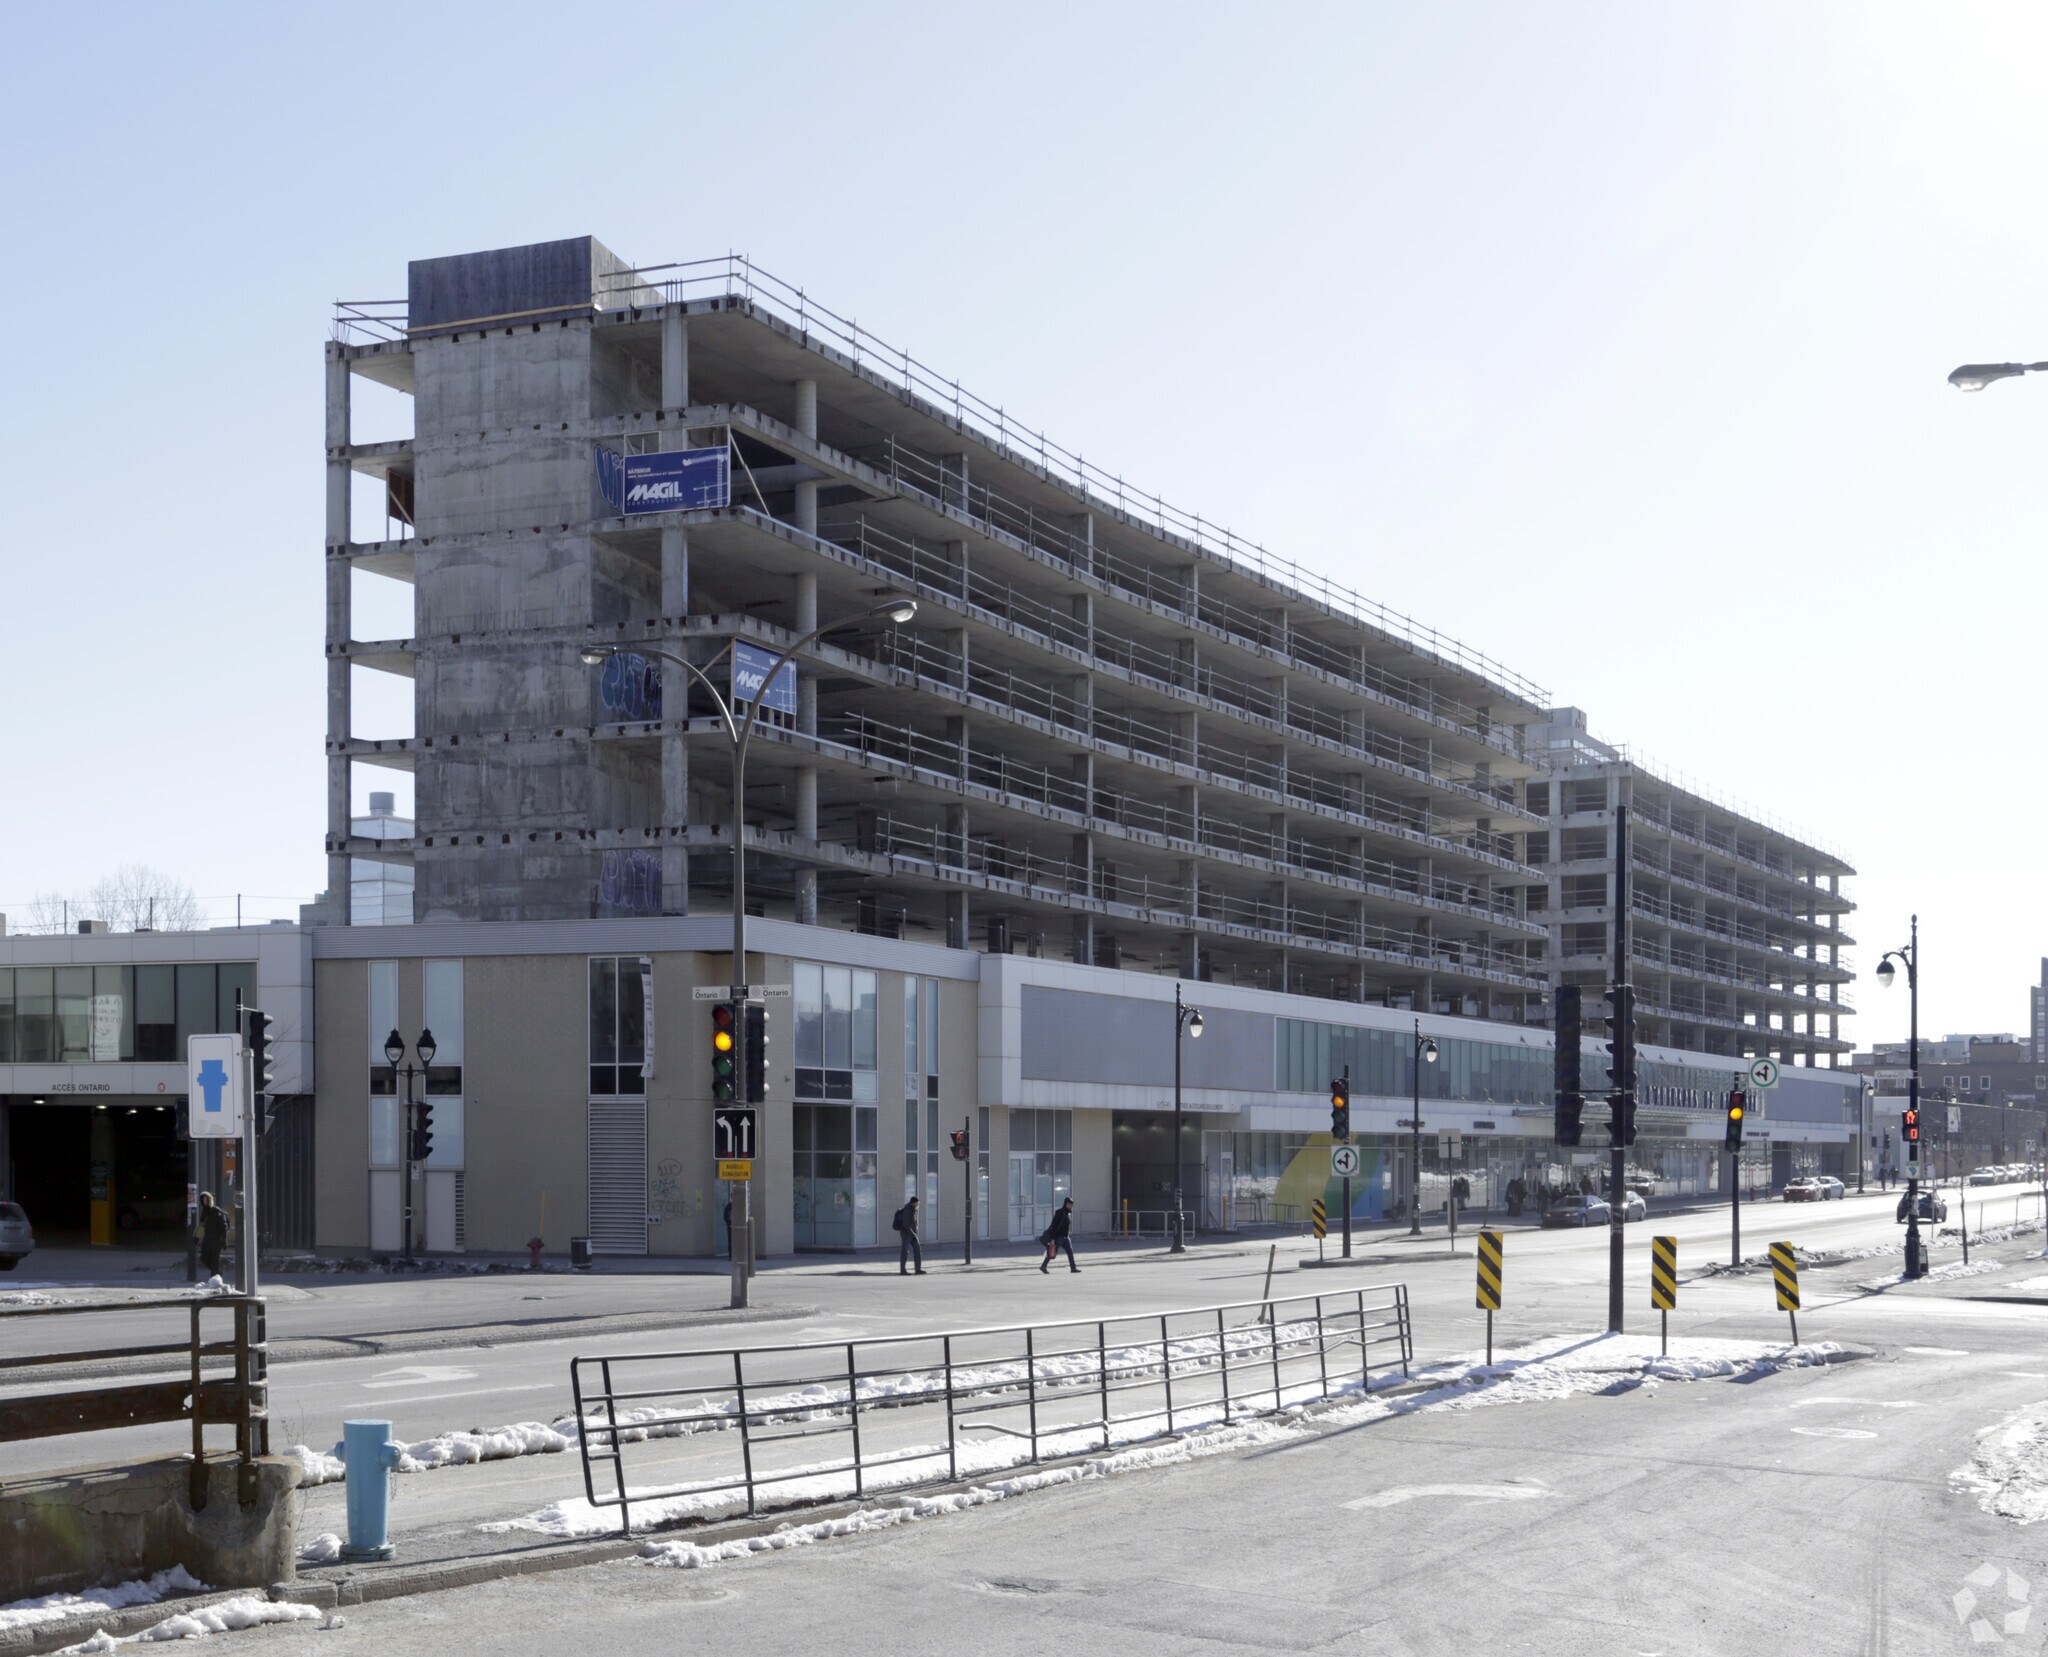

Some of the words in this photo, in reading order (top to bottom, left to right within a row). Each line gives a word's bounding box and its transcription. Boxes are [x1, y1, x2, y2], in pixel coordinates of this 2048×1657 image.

[627, 481, 683, 501] MAGIL
[695, 991, 718, 999] Ontario
[763, 989, 789, 997] Ontario
[78, 1084, 110, 1092] ONTARIO
